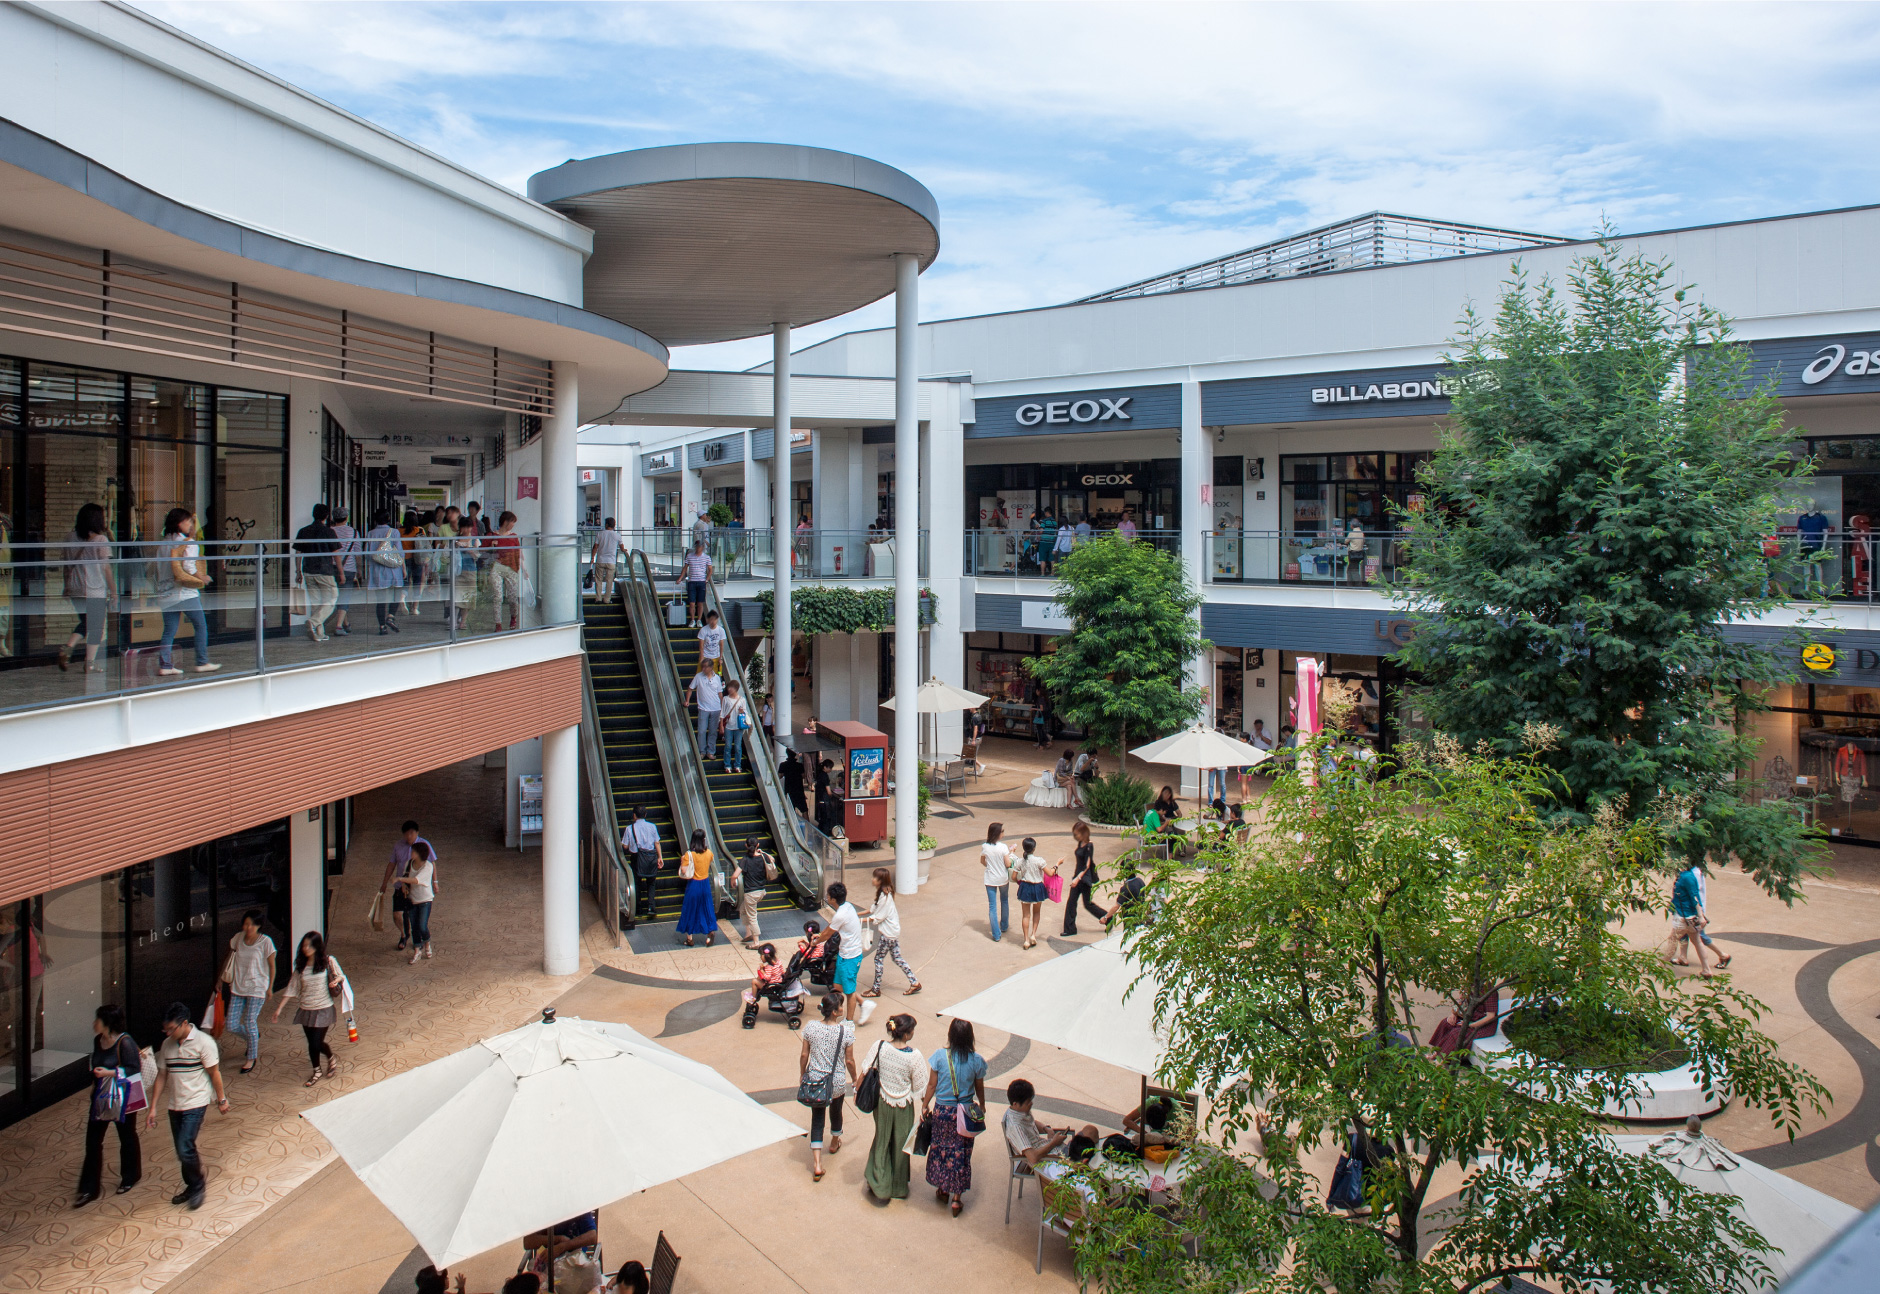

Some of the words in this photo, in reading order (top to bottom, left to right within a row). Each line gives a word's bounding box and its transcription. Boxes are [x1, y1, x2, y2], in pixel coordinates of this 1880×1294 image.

[1015, 397, 1132, 426] GEOX
[1081, 473, 1133, 486] GEOX
[980, 508, 1023, 520] SALE
[1248, 655, 1259, 665] UGG
[975, 661, 1008, 673] SALE
[139, 911, 208, 947] theory
